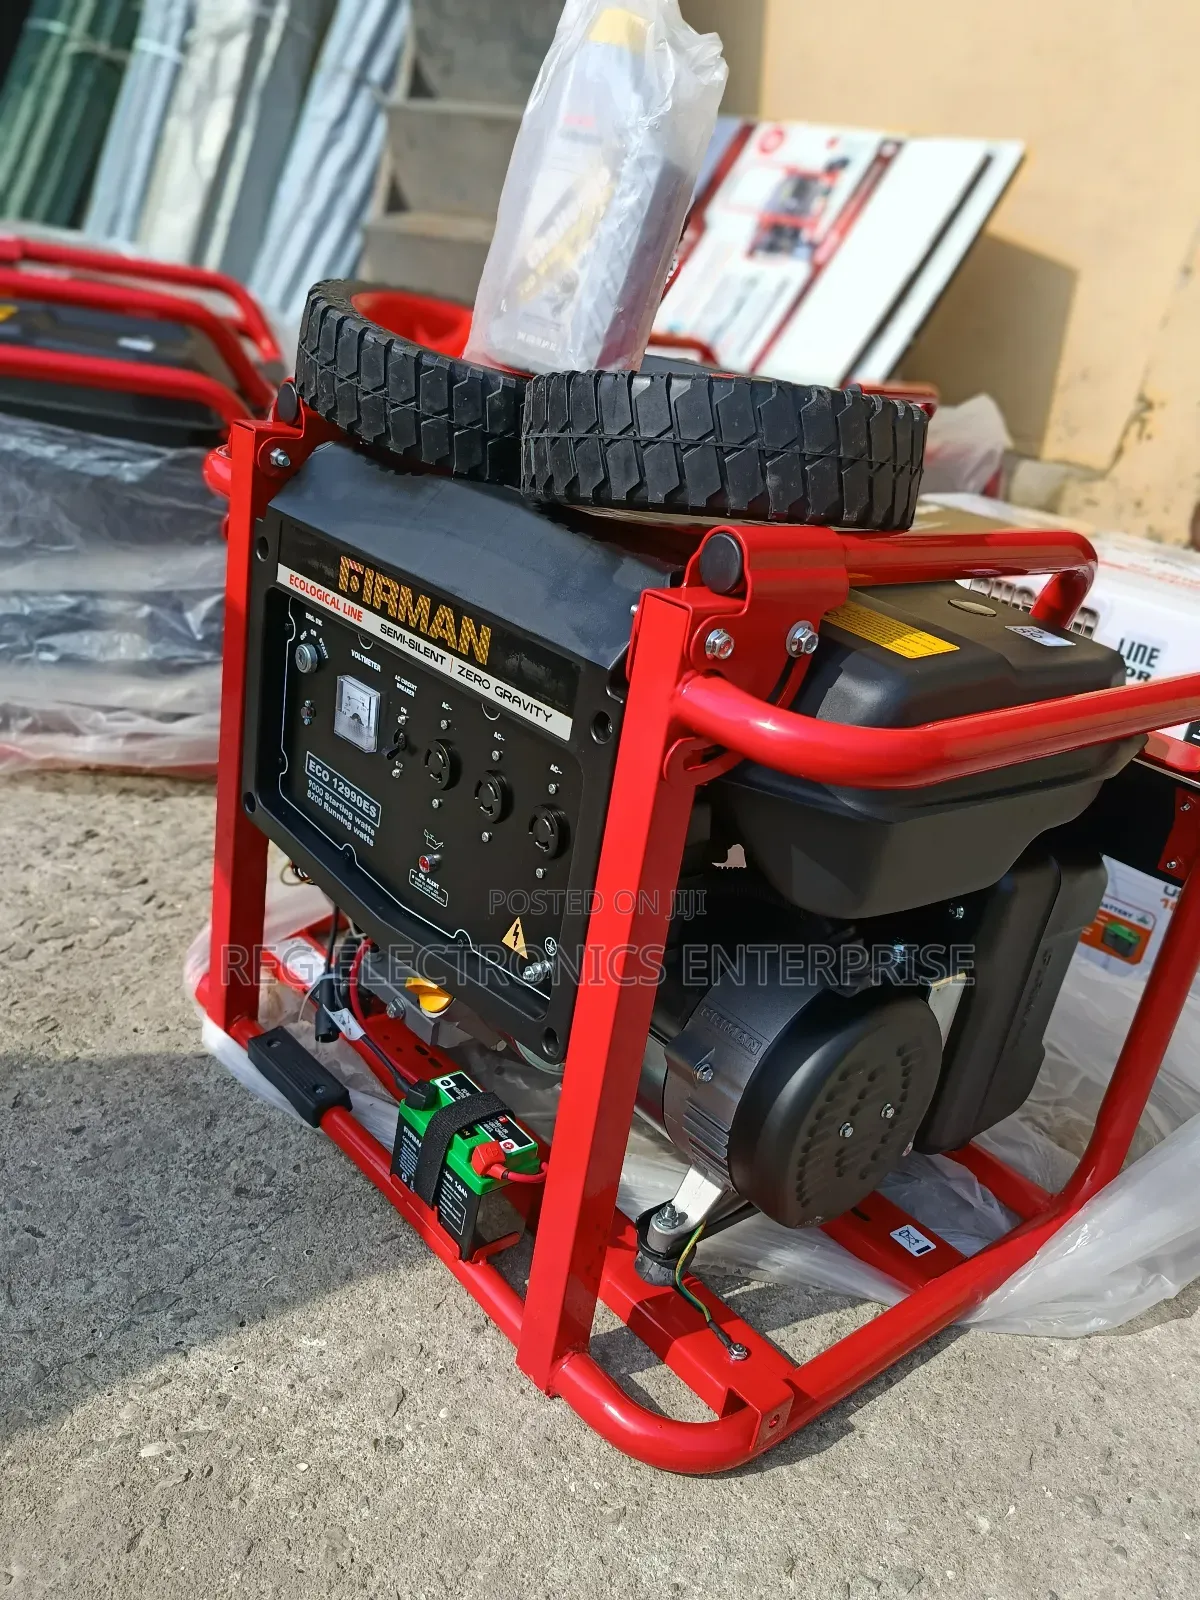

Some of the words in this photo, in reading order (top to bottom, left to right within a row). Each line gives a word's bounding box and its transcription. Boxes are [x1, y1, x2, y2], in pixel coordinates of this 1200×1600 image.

[289, 573, 341, 612] ECOLOGICAL
[343, 603, 363, 623] LINE
[339, 556, 492, 666] FIRMAN
[319, 637, 329, 659] START
[351, 649, 381, 673] VOLTMETER
[379, 623, 447, 666] SEMI-SILENT
[457, 665, 491, 690] ZERO
[494, 685, 553, 722] GRAVITY
[1117, 637, 1161, 668] LINE
[308, 779, 324, 797] 9000
[324, 792, 353, 821] Starting
[354, 815, 375, 837] watts
[309, 759, 330, 782] ECO
[332, 777, 377, 818] 12990ES
[306, 789, 323, 807] 8200
[323, 802, 352, 831] Running
[353, 826, 374, 847] watts
